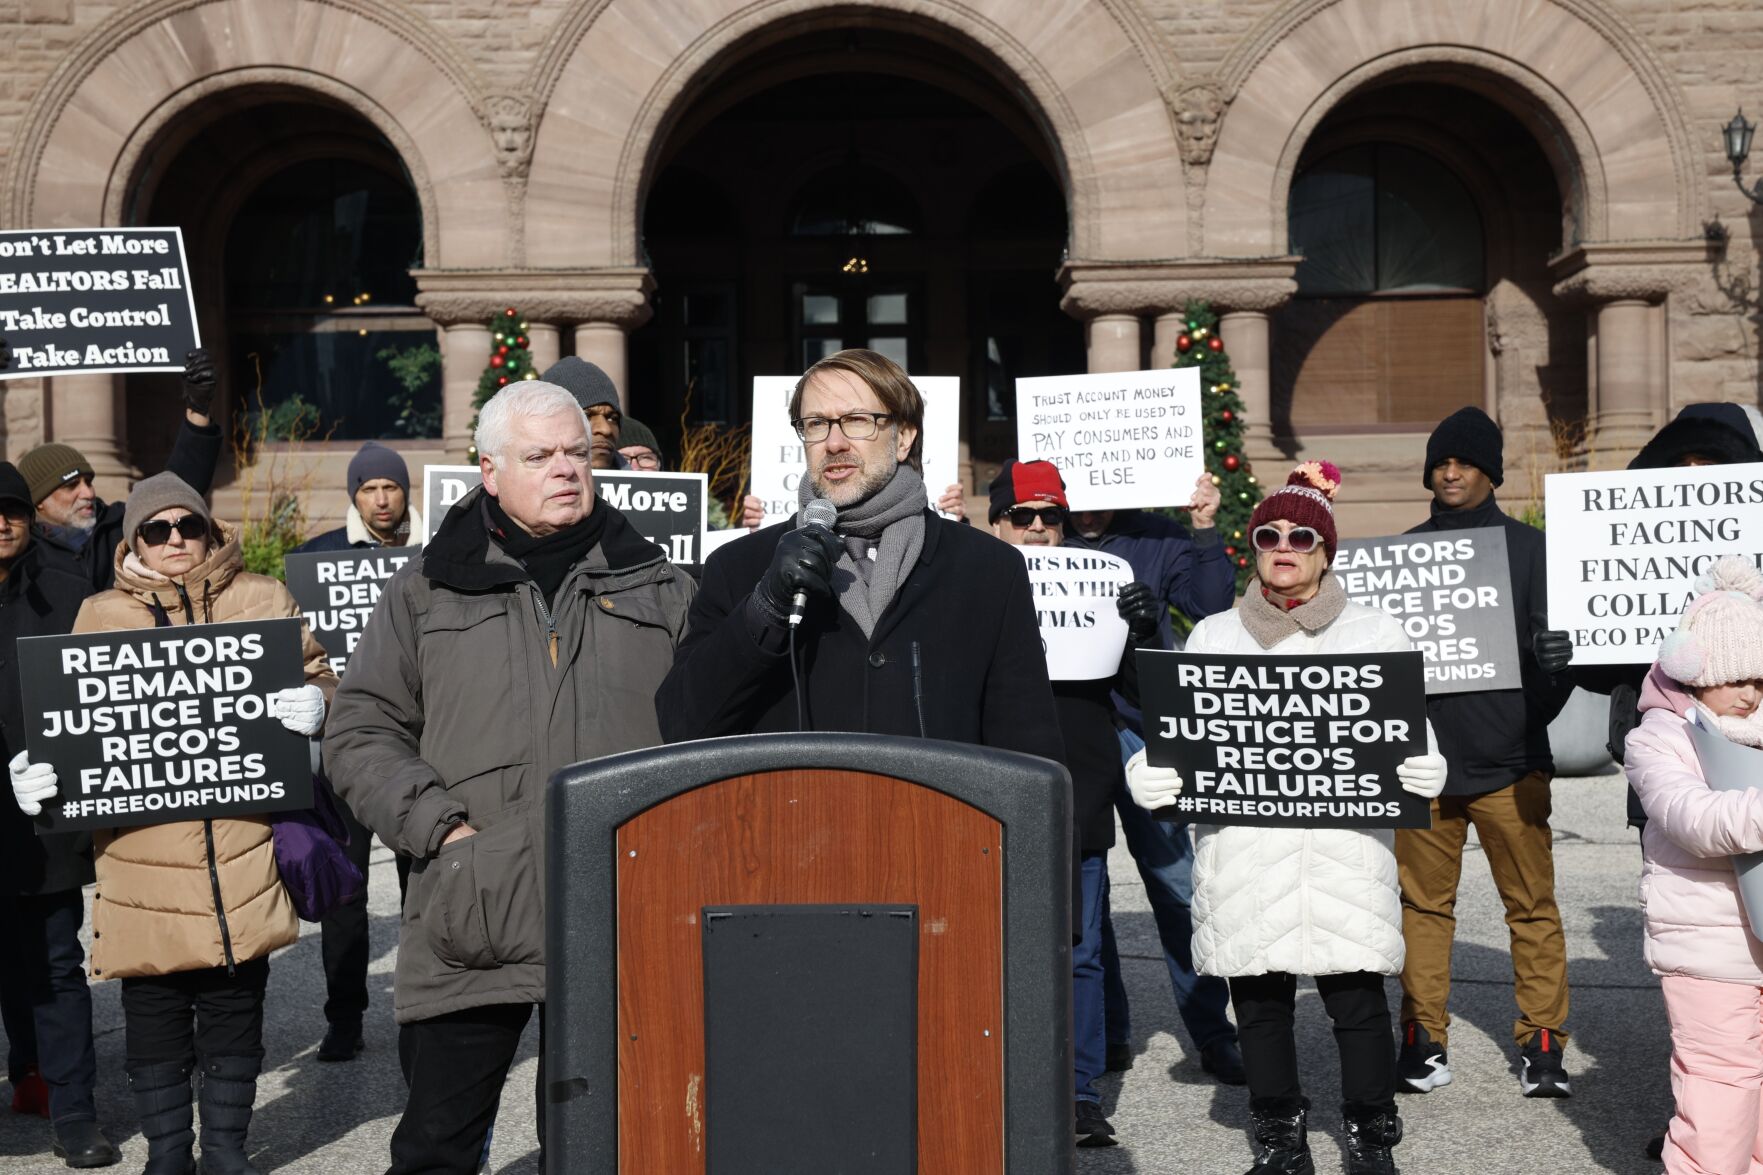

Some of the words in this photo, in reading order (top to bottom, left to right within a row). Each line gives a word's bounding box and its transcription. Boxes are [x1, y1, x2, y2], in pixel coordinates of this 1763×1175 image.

[0, 235, 52, 257] on't
[53, 235, 98, 255] Let
[100, 234, 169, 255] More
[0, 270, 129, 293] EALTORS
[132, 267, 181, 290] Fall
[0, 306, 67, 331] Take
[70, 303, 171, 328] Control
[13, 344, 81, 368] Take
[84, 341, 170, 365] Action
[1032, 392, 1071, 407] TRUST
[1076, 389, 1127, 404] ACCOUNT
[1133, 386, 1176, 400] MONEY
[1032, 413, 1071, 425] SHOULD
[1079, 408, 1111, 421] ONLY
[1116, 408, 1131, 419] BE
[1135, 406, 1166, 419] USED
[1170, 405, 1185, 416] TO
[1032, 430, 1066, 452] PAY
[1073, 426, 1158, 446] CONSUMERS
[1165, 425, 1193, 439] AND
[1100, 451, 1131, 463] AND
[1136, 448, 1156, 461] NO
[1164, 445, 1194, 459] ONE
[1089, 467, 1136, 486] ELSE
[601, 483, 688, 512] More
[1581, 479, 1763, 511] REALTORS
[1609, 517, 1742, 546] FACING
[1065, 557, 1120, 571] KIDS
[1332, 538, 1475, 571] EALTORS
[316, 556, 409, 584] REALT
[1432, 586, 1499, 611] FOR
[1037, 610, 1095, 629] TMAS
[1574, 628, 1627, 647] ECO
[1634, 626, 1678, 646] PA
[61, 634, 265, 674] REALTORS
[77, 665, 253, 704] DEMAND
[1177, 664, 1384, 690] REALTORS
[1424, 663, 1496, 682] FUNDS
[1193, 692, 1371, 717] DEMAND
[42, 699, 202, 738] JUSTICE
[1159, 716, 1315, 744] JUSTICE
[1329, 719, 1410, 743] FOR
[102, 726, 241, 763] RECO'S
[1216, 746, 1356, 771] RECO'S
[80, 753, 266, 794] FAILURES
[1194, 770, 1382, 798] FAILURES
[62, 781, 286, 819] #FREEOURFUNDS
[1178, 796, 1401, 818] #FREEOURFUNDS
